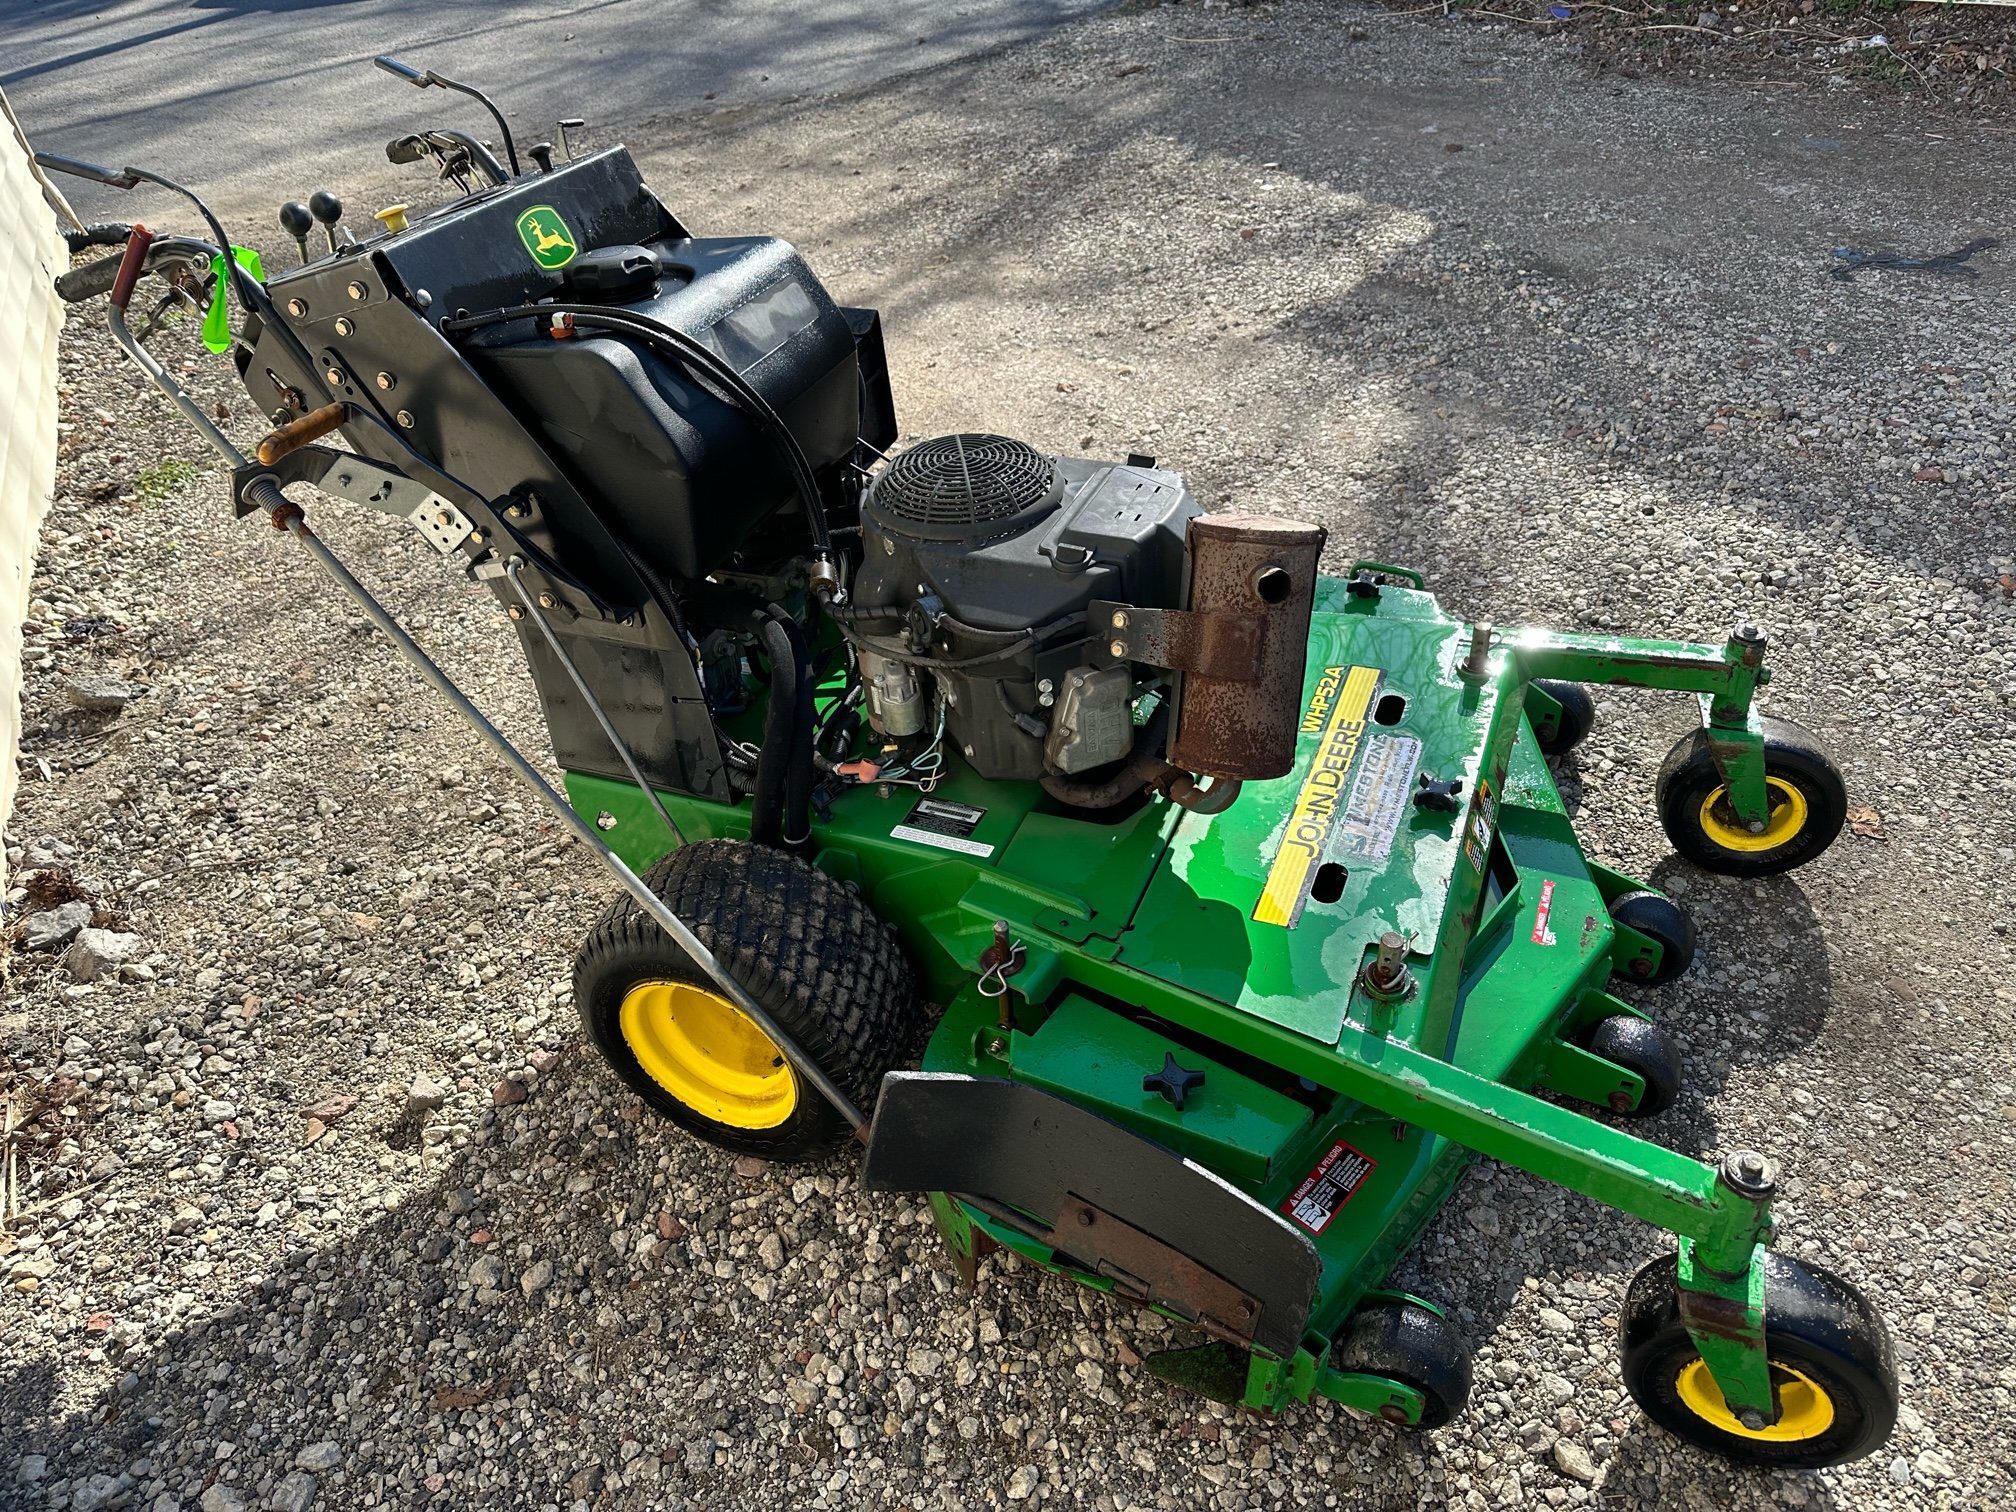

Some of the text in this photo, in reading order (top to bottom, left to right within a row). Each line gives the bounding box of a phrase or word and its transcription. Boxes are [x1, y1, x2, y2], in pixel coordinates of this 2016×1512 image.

[1300, 666, 1345, 733] WHP52A
[1287, 718, 1362, 858] JOHN DEERE
[1294, 1144, 1343, 1200] DANGER PELIGRO
